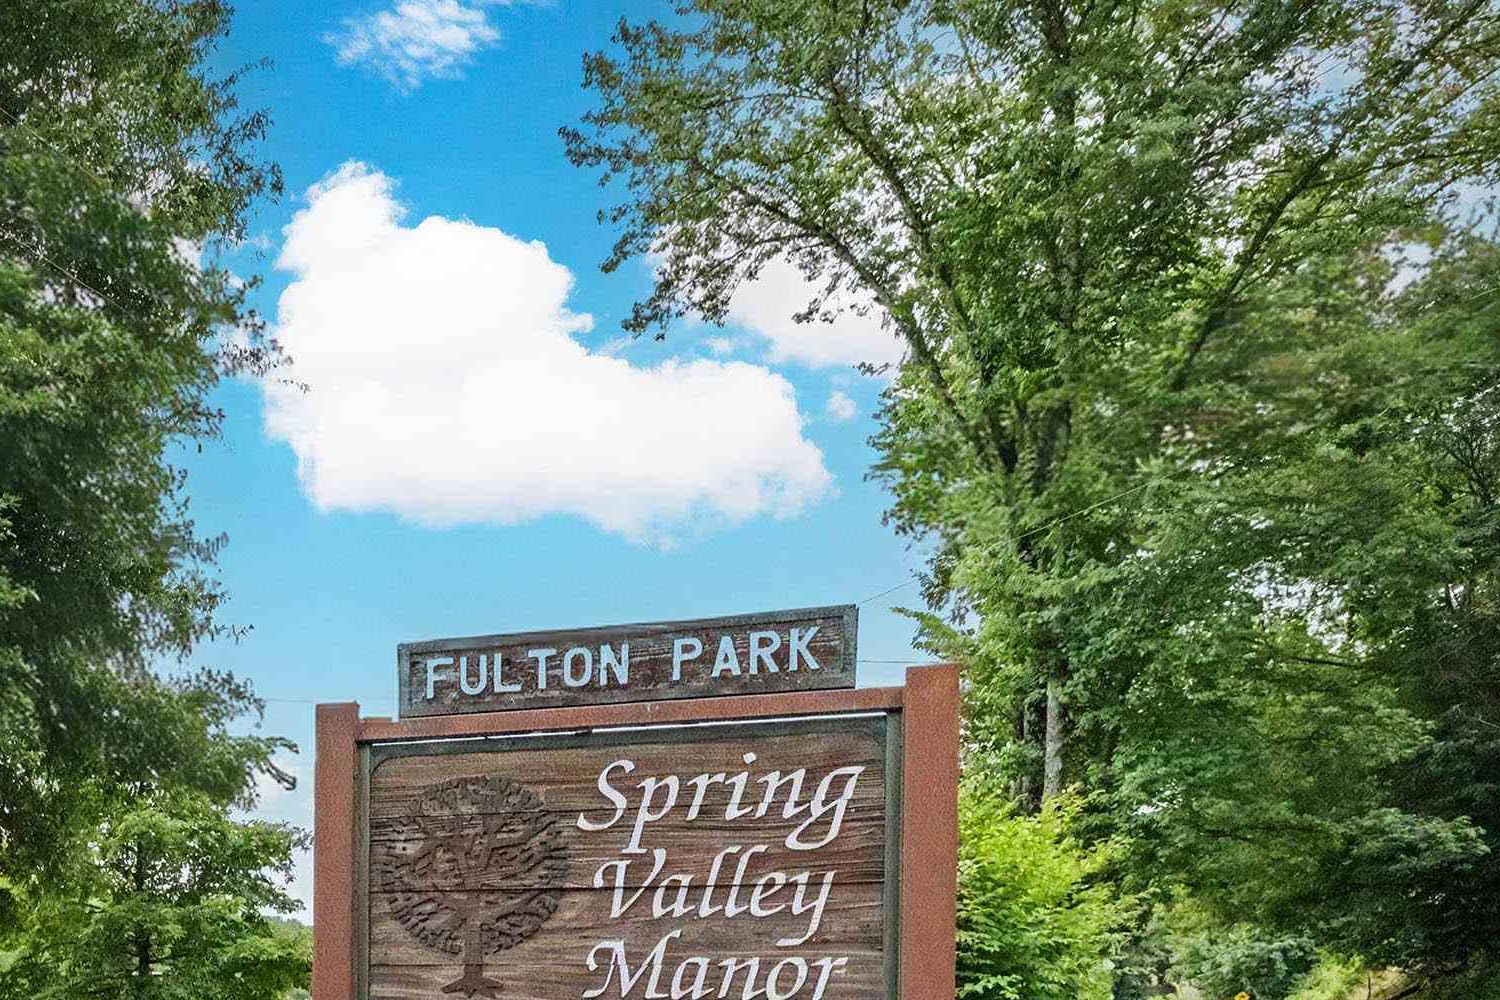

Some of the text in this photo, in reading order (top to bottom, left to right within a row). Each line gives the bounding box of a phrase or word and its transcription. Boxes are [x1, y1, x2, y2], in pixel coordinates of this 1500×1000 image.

[423, 625, 822, 699] FULTON PARK
[576, 751, 866, 853] Spring
[593, 844, 836, 946] Valley
